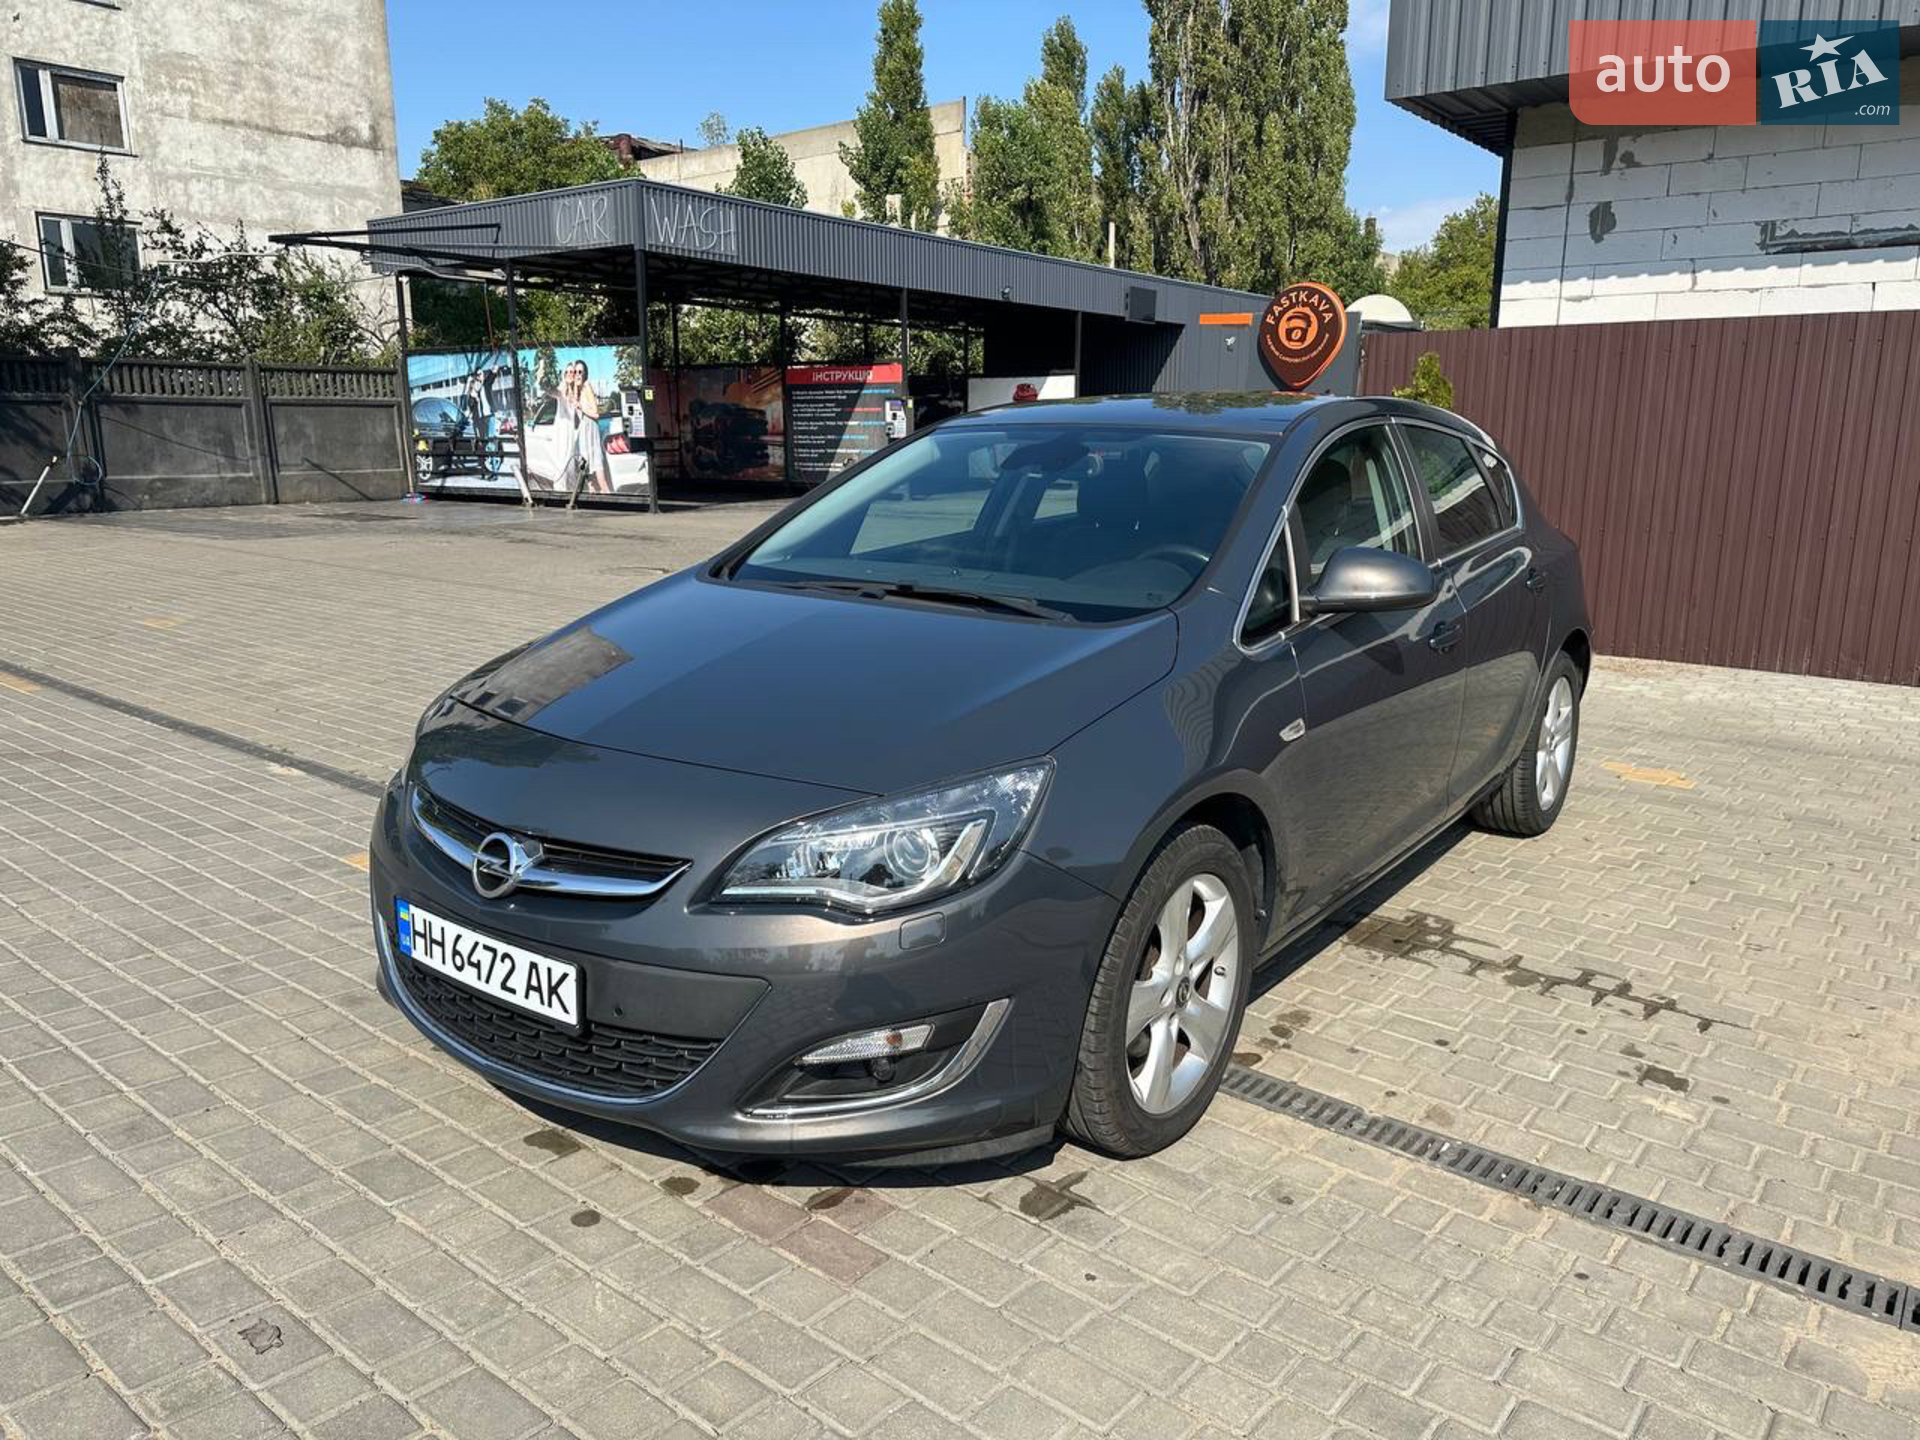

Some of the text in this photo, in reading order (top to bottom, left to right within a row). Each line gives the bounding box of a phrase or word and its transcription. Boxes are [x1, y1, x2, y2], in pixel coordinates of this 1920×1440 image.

[555, 196, 737, 251] CAR WASH
[1265, 290, 1333, 325] FASTKAVA
[411, 913, 571, 1015] HH 6472 AK
